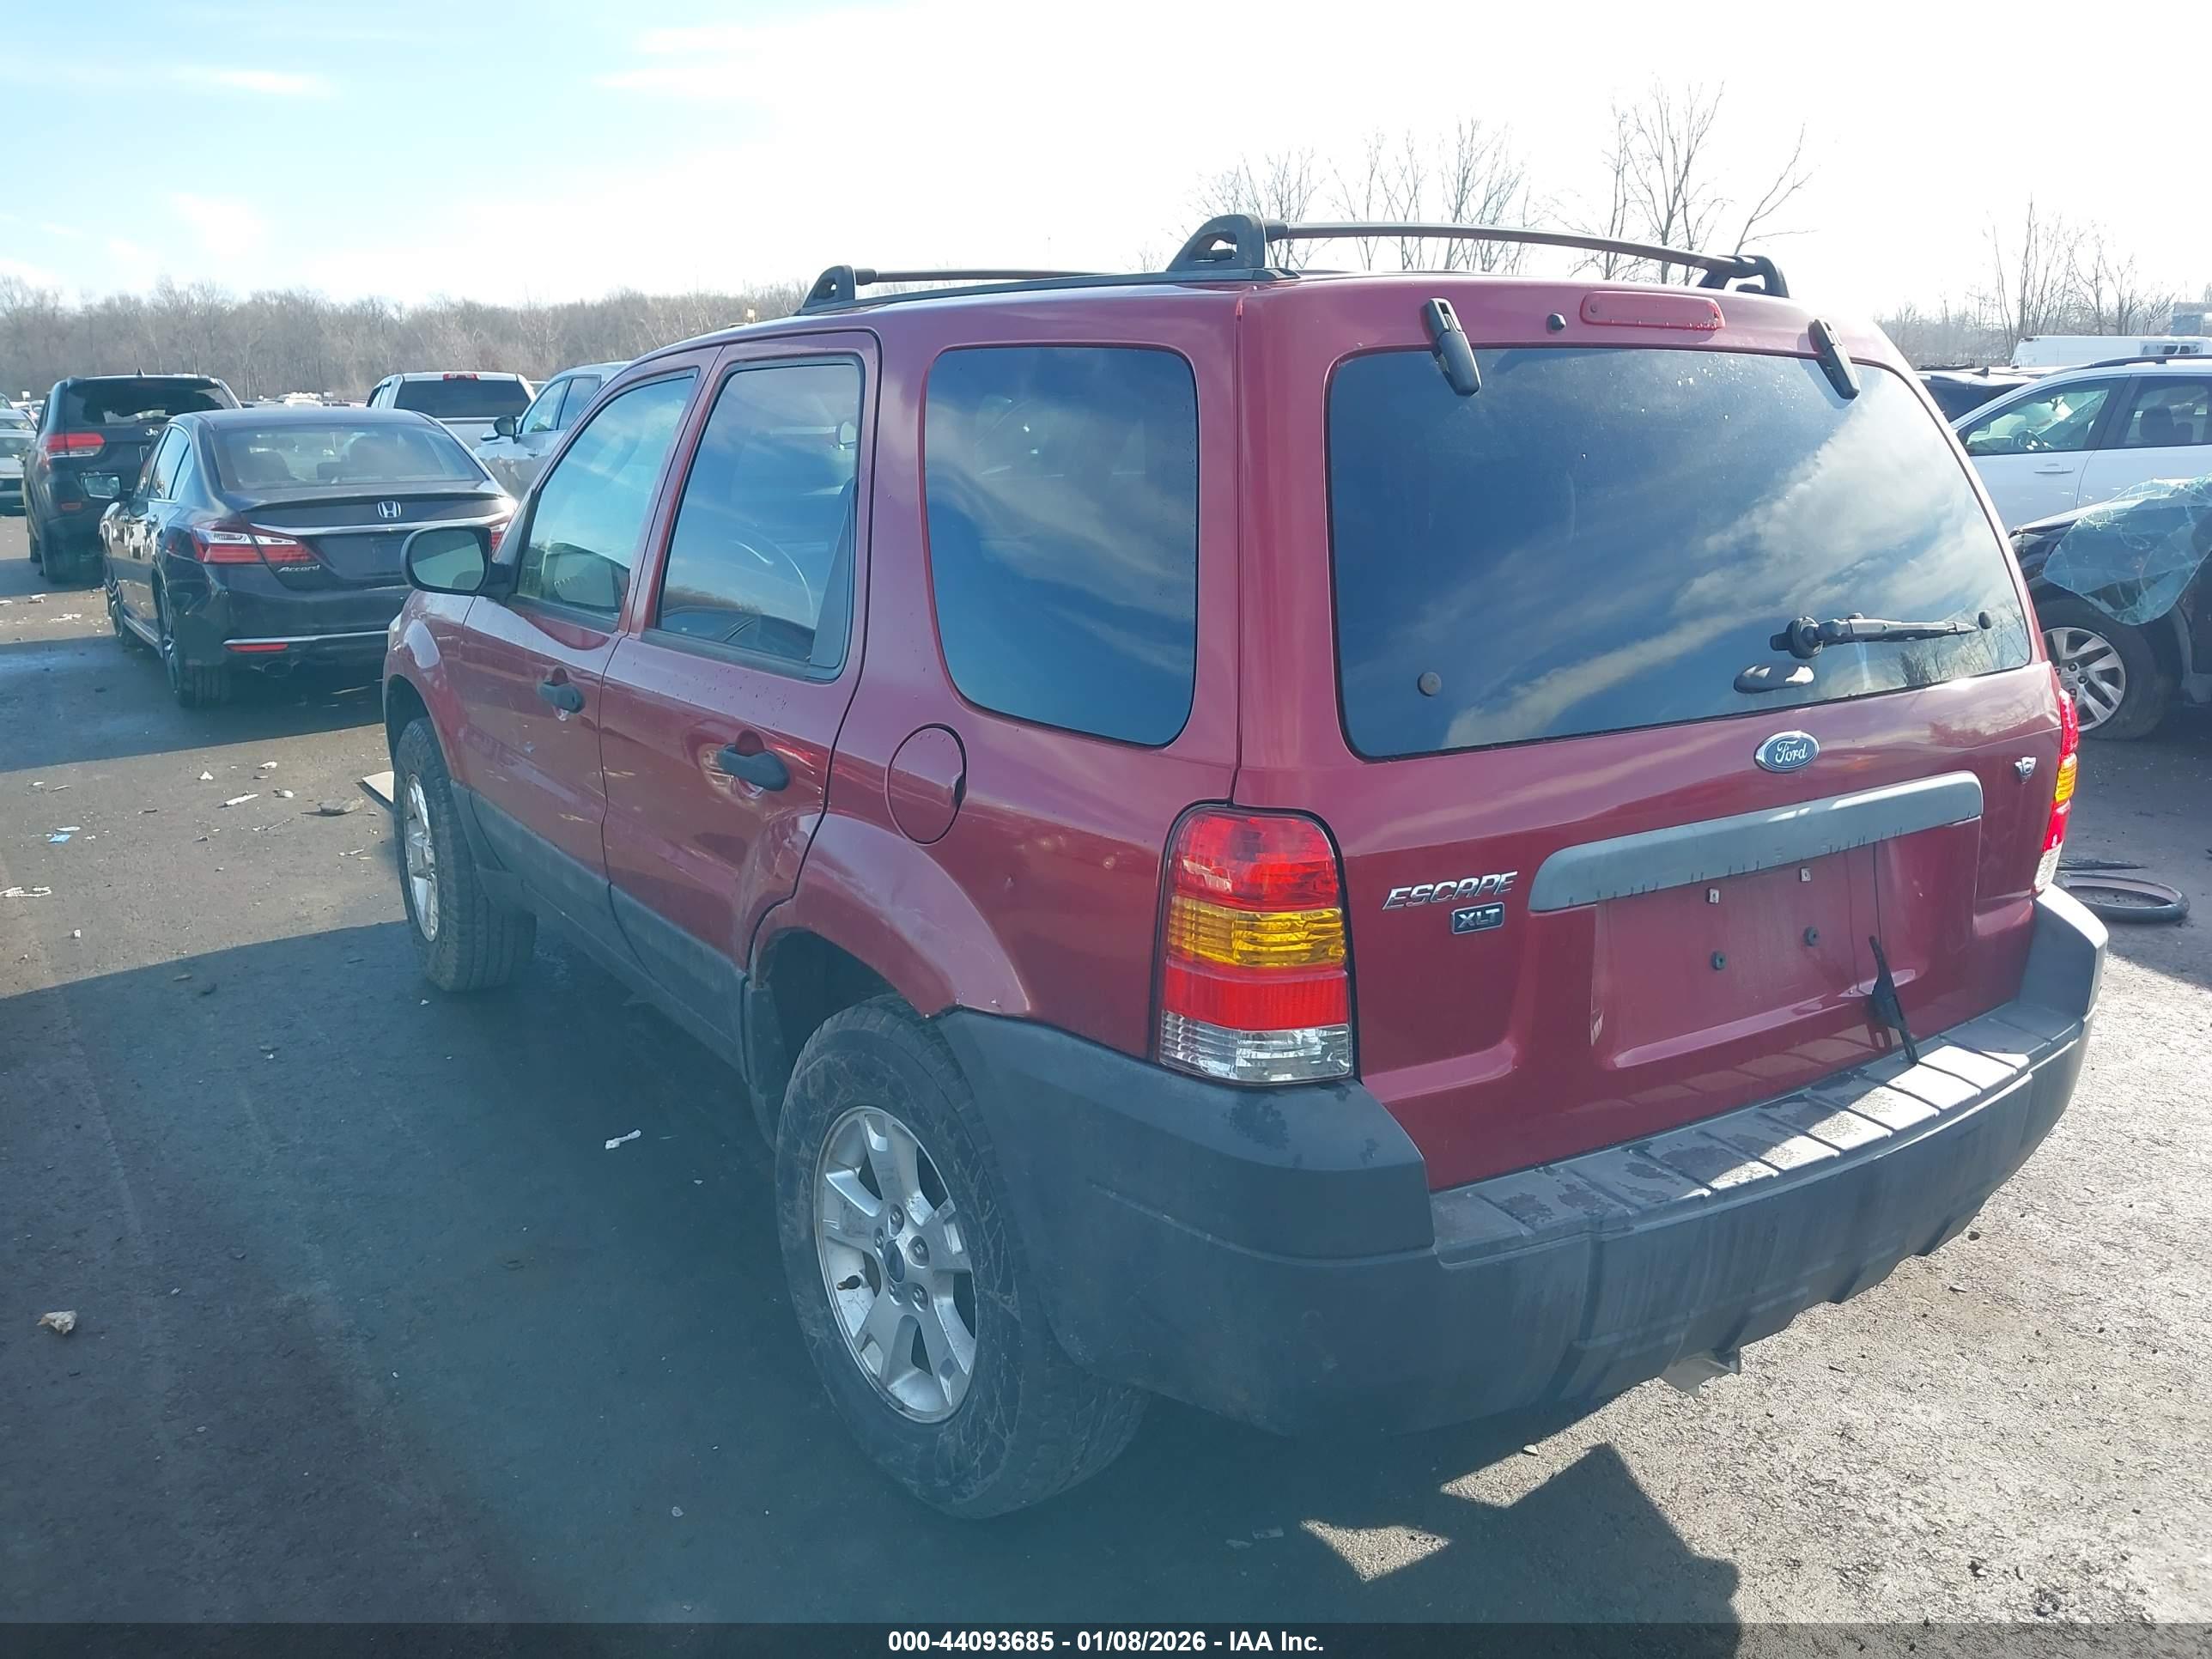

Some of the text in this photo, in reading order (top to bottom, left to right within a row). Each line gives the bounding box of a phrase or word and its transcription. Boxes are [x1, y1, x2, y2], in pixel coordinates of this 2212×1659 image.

[277, 564, 320, 573] Accord
[1775, 739, 1808, 763] Ford
[1382, 871, 1518, 910] ESCAPE
[1457, 908, 1501, 929] XLT
